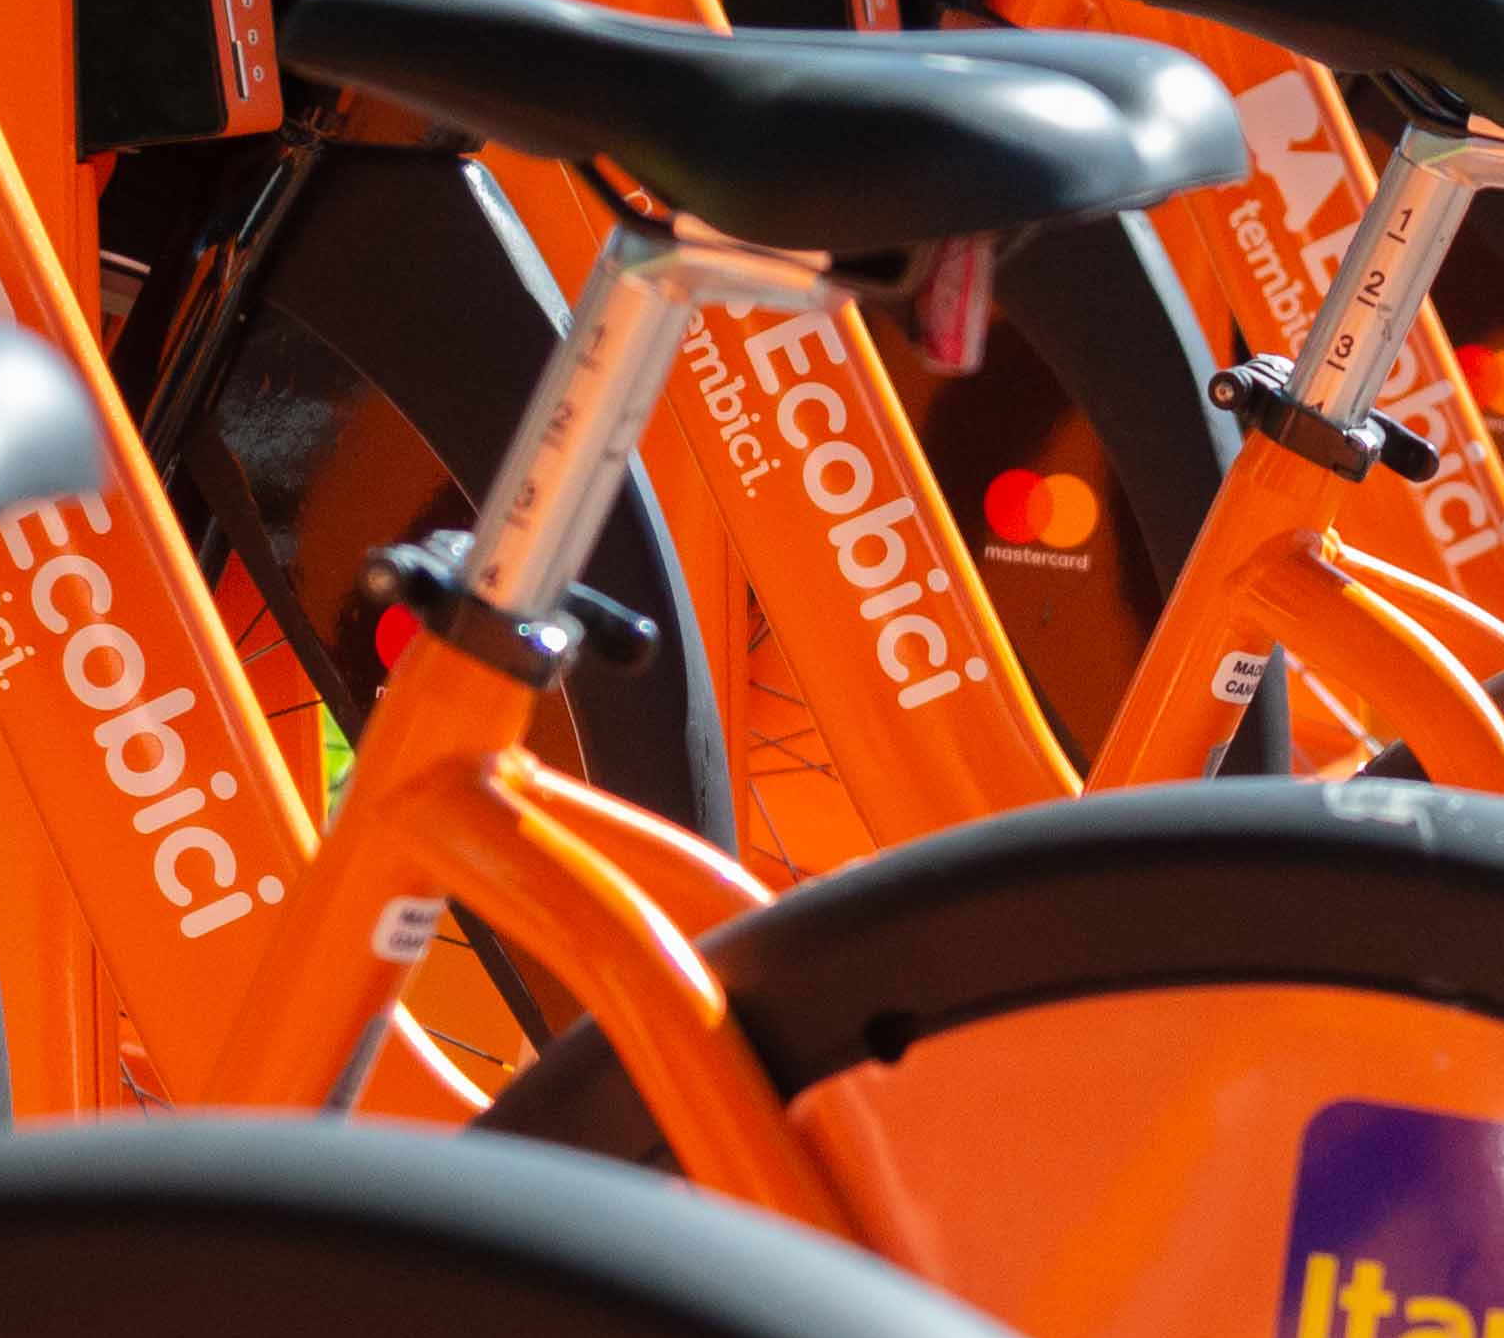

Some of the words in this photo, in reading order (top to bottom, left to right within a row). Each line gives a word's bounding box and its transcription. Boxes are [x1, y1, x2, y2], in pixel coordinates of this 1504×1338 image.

[1400, 208, 1414, 232] 1
[1363, 270, 1385, 297] 2
[1334, 334, 1355, 359] 3
[743, 309, 988, 710] Ecobici
[983, 545, 1091, 572] mastercard
